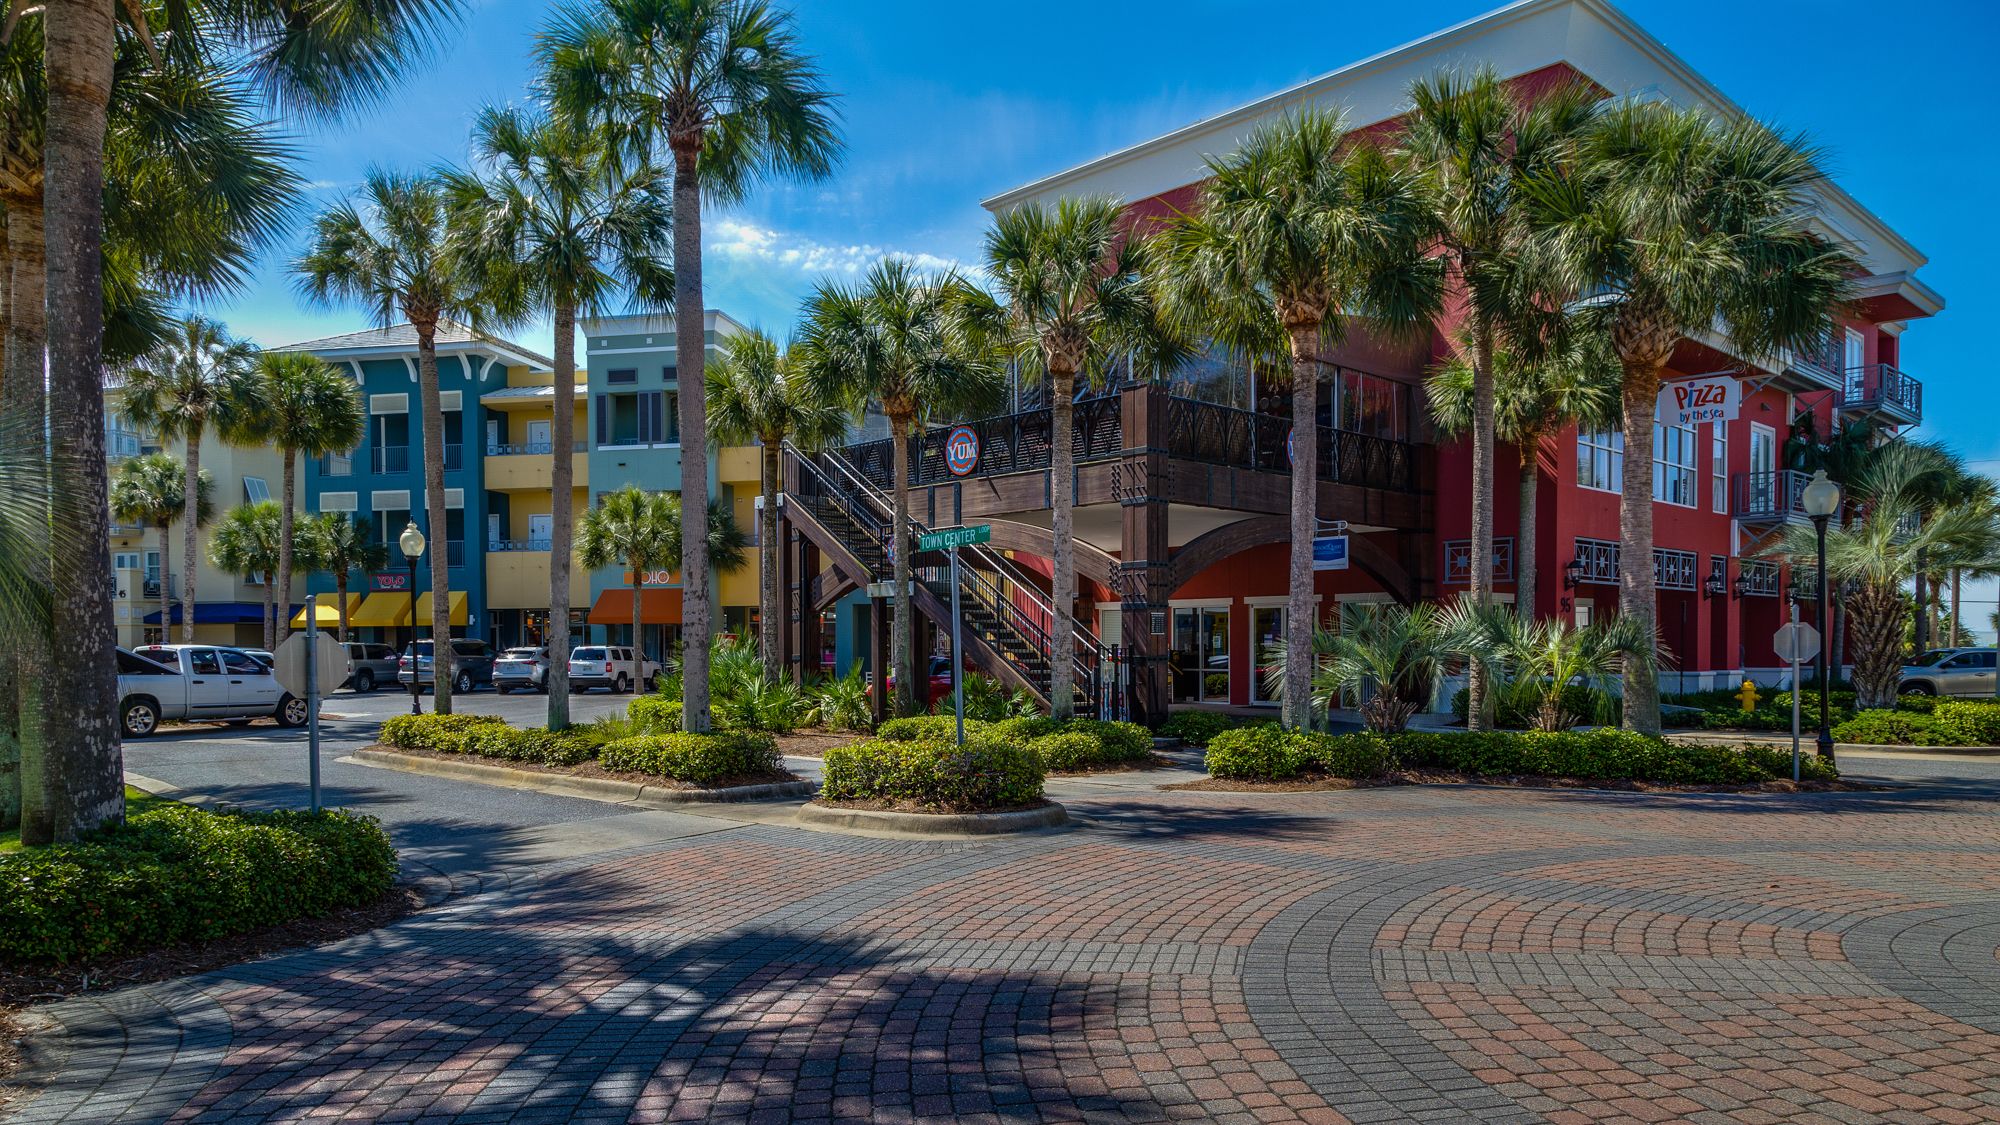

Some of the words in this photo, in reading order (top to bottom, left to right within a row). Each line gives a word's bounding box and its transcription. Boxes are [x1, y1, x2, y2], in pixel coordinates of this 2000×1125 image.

[1674, 381, 1726, 410] Pizza
[1680, 412, 1690, 424] by
[1692, 409, 1708, 420] the
[947, 442, 977, 461] YUM
[921, 534, 943, 550] TOWN
[944, 529, 976, 546] CENTER
[377, 575, 405, 586] YOLO
[634, 570, 670, 584] OHO
[1560, 597, 1571, 613] 95
